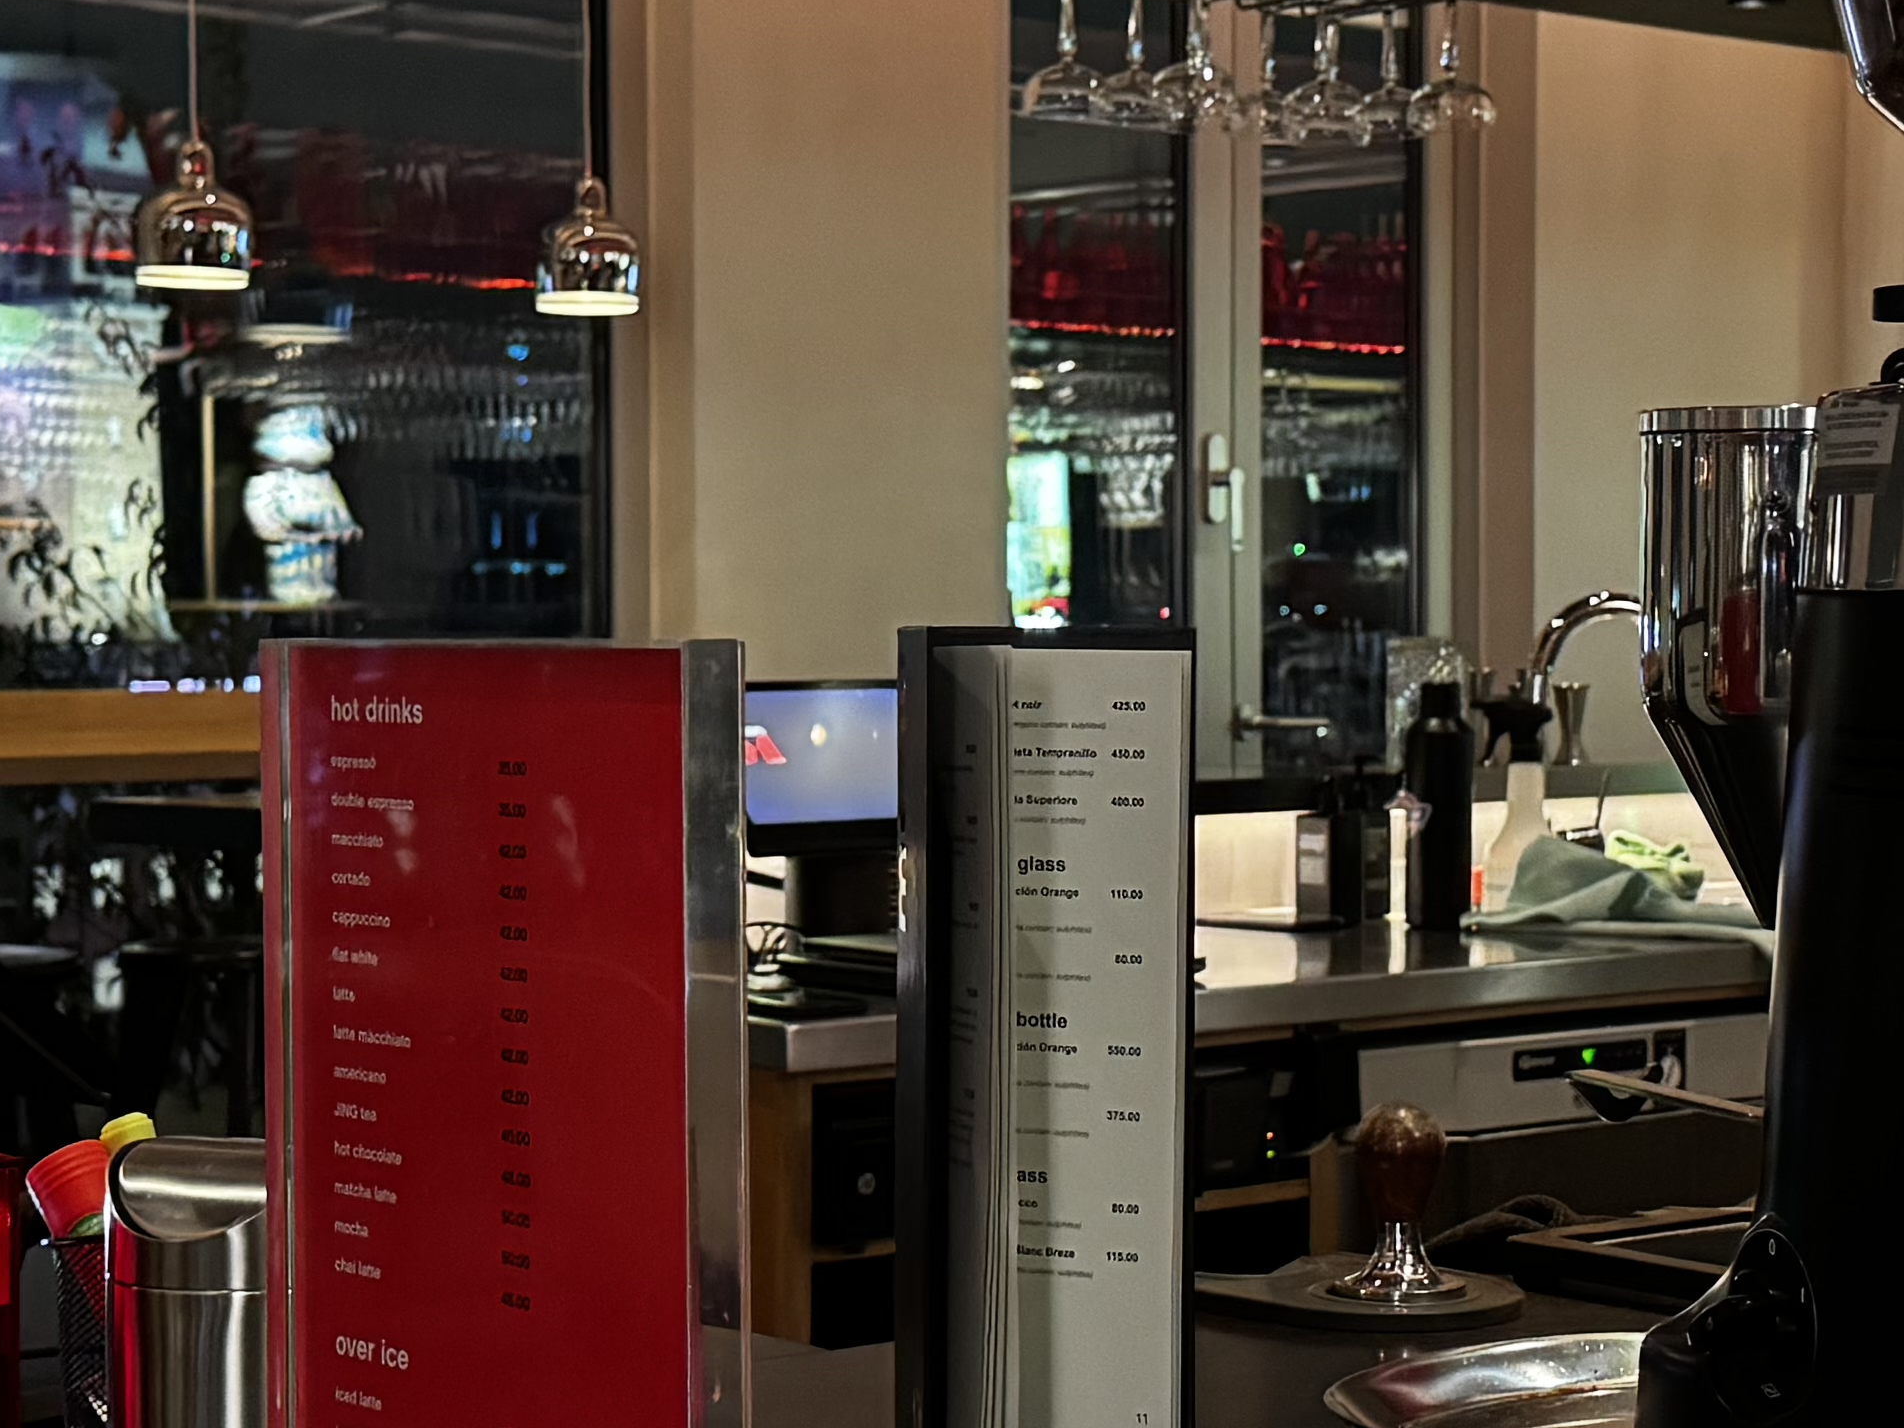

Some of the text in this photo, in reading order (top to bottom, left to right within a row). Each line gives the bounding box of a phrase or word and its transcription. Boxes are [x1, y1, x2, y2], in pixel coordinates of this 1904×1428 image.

[331, 695, 422, 724] hot drinks
[331, 756, 376, 771] espresso
[332, 834, 384, 848] macchiato
[1018, 856, 1065, 875] glass
[332, 872, 370, 886] cortado
[1040, 886, 1078, 899] Orange
[1111, 890, 1143, 899] 110.00
[333, 912, 390, 927] cappuccino
[333, 986, 355, 1002] latte
[1017, 1011, 1067, 1028] bottle
[359, 1031, 411, 1047] macchiato
[1038, 1042, 1077, 1056] Orange
[1108, 1046, 1141, 1056] 550.00
[360, 1108, 376, 1121] tea
[1107, 1111, 1140, 1122] 375.00
[335, 1141, 350, 1156] hot
[353, 1144, 402, 1165] chocolate
[1112, 1203, 1139, 1214] 80.00
[335, 1221, 368, 1237] mocha
[335, 1258, 356, 1273] chai
[336, 1336, 408, 1370] over ice
[1137, 1413, 1147, 1425] 11
